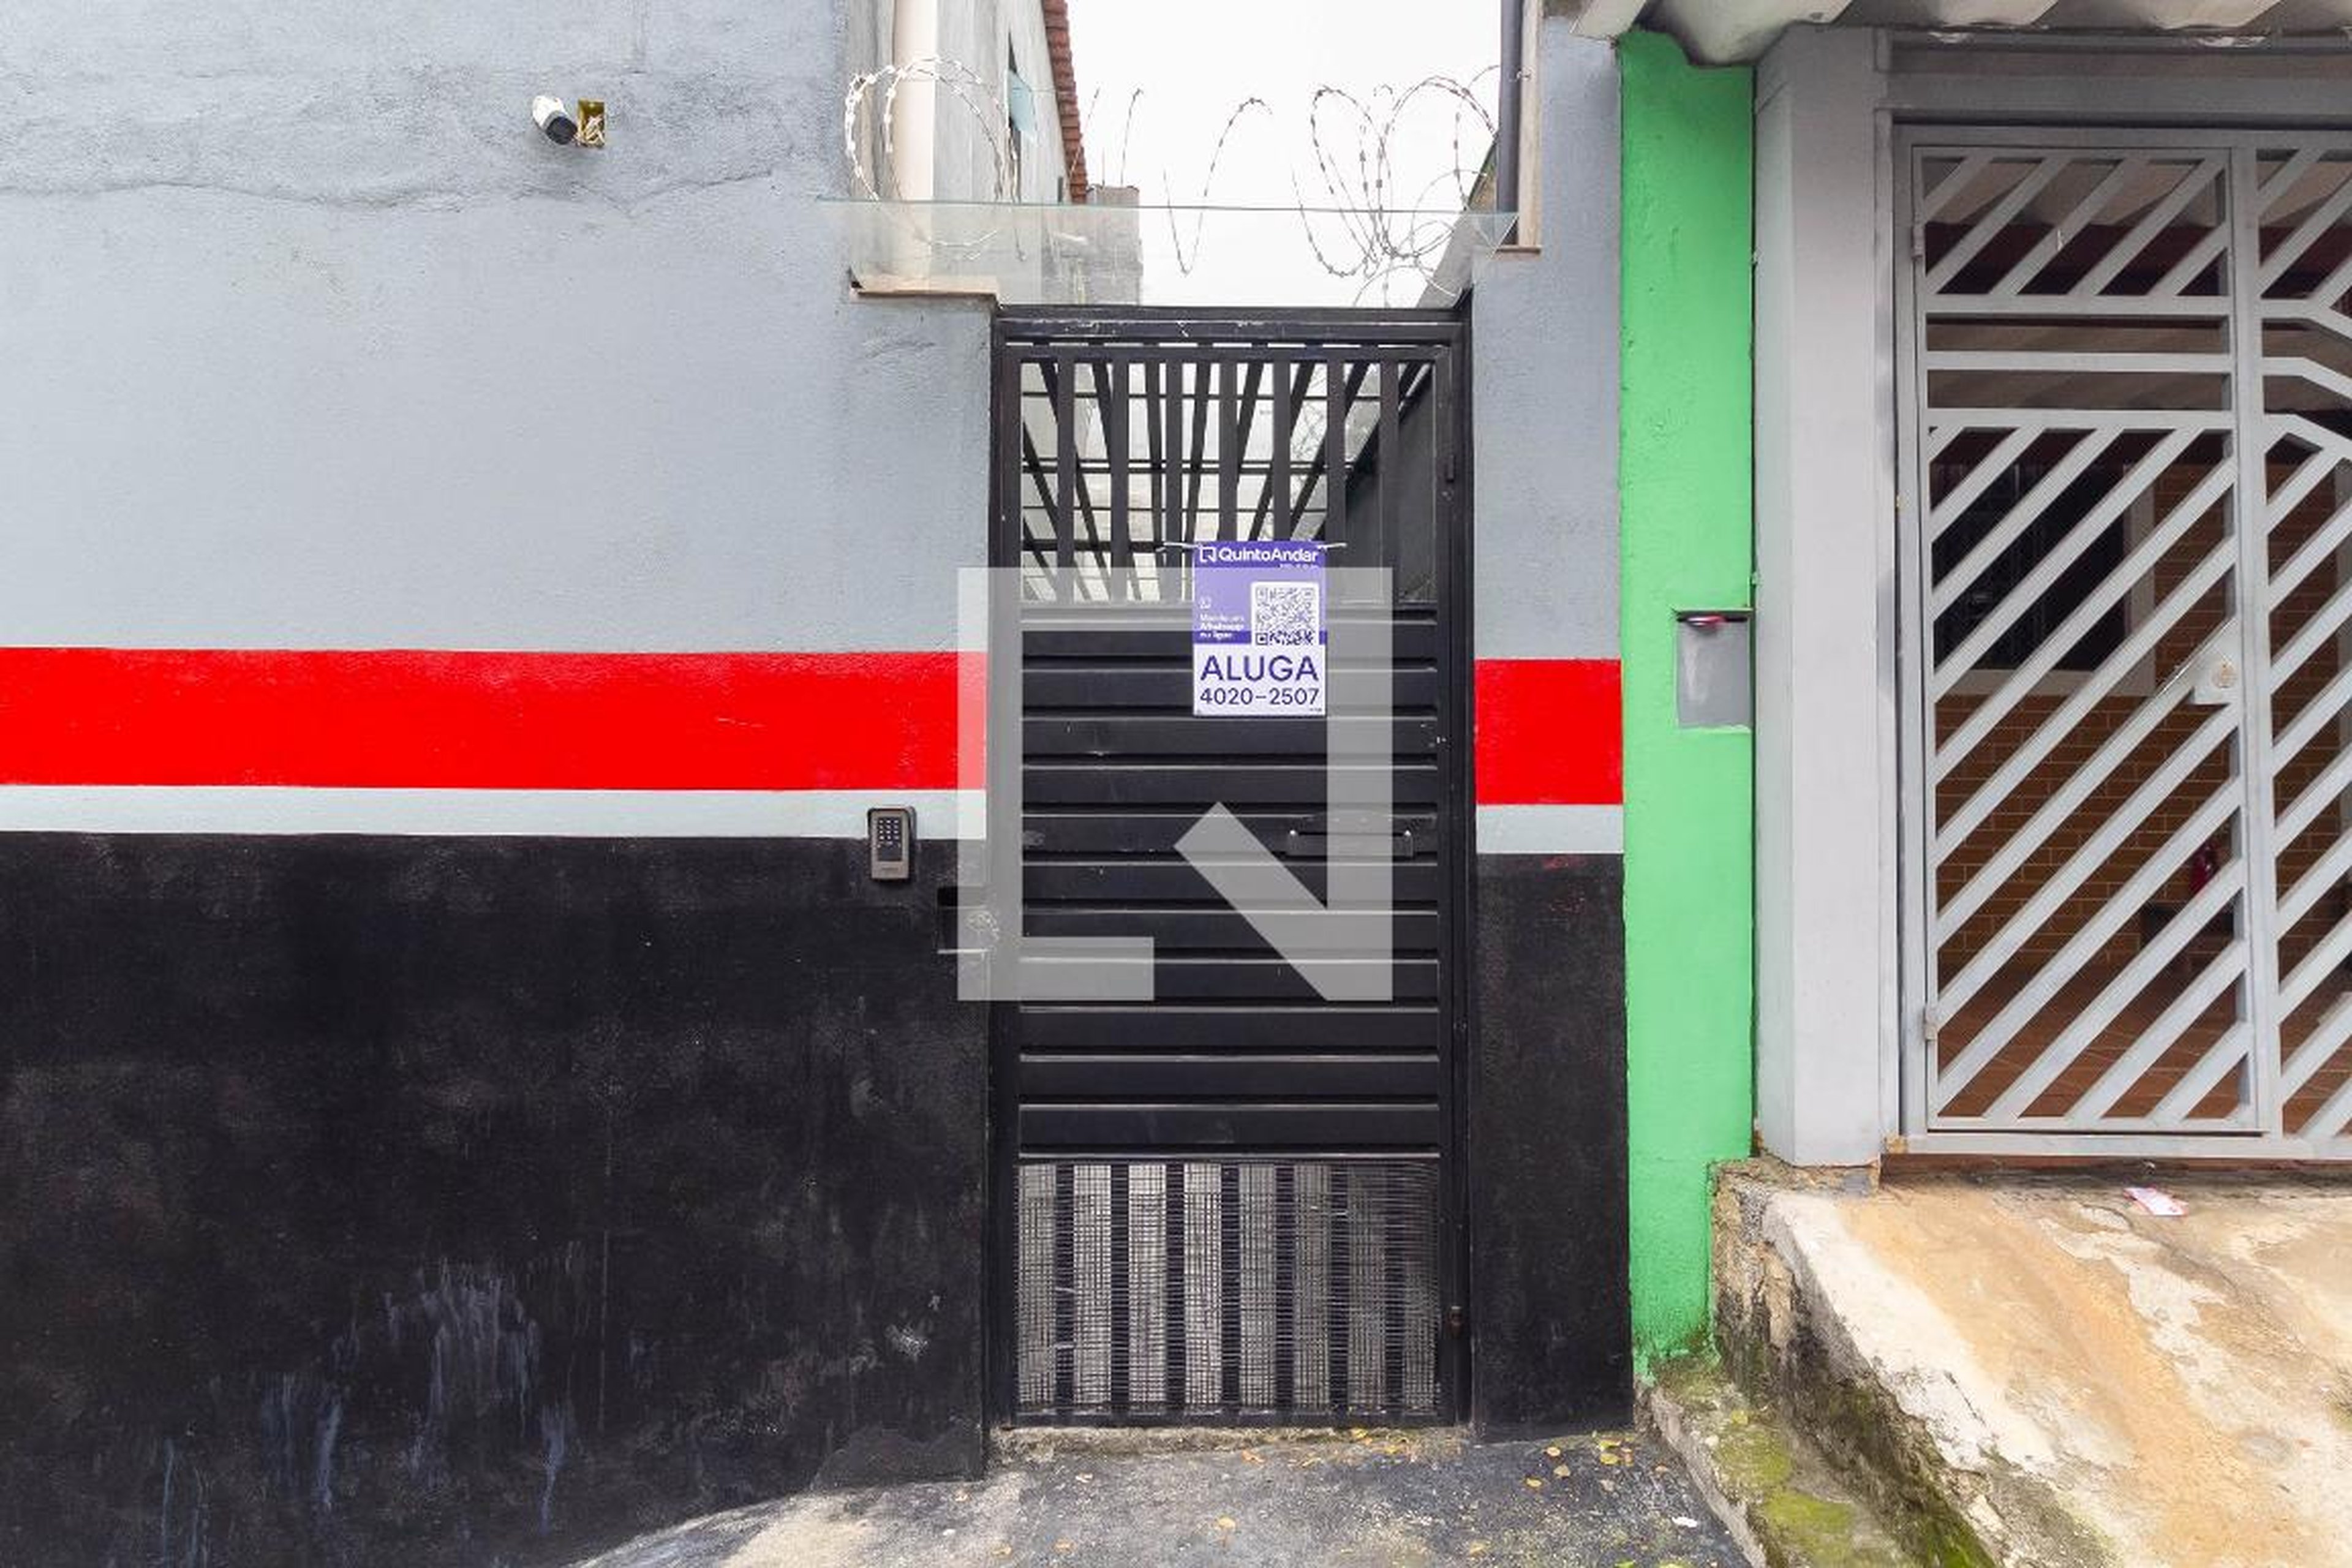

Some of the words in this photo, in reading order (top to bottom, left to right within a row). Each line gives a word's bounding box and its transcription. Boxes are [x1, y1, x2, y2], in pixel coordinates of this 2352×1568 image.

[1219, 548, 1317, 562] QuintoAndar
[1200, 655, 1319, 681] ALUGA
[1200, 687, 1319, 704] 4020-2507
